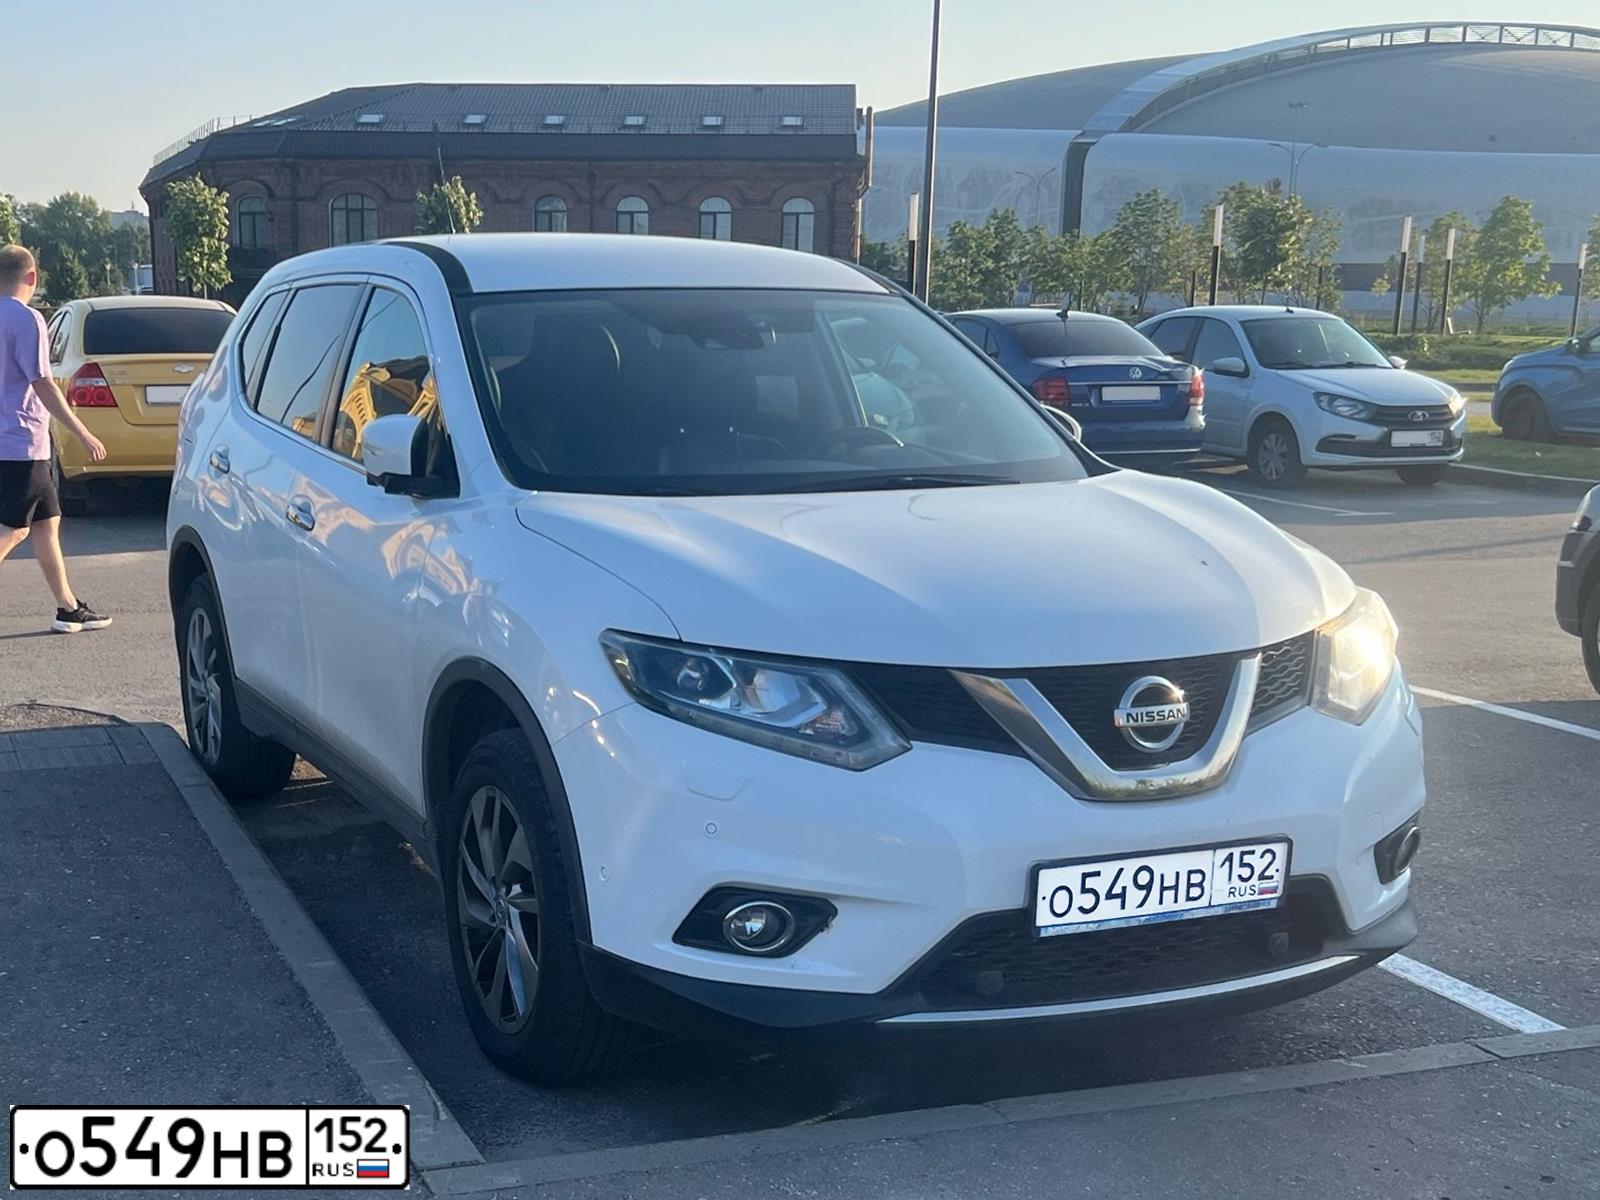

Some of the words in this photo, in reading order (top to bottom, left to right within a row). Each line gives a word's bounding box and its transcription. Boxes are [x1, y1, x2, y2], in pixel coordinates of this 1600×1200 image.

[1126, 707, 1186, 723] NISSAN
[1219, 848, 1276, 883] 152
[1228, 884, 1257, 898] RUS
